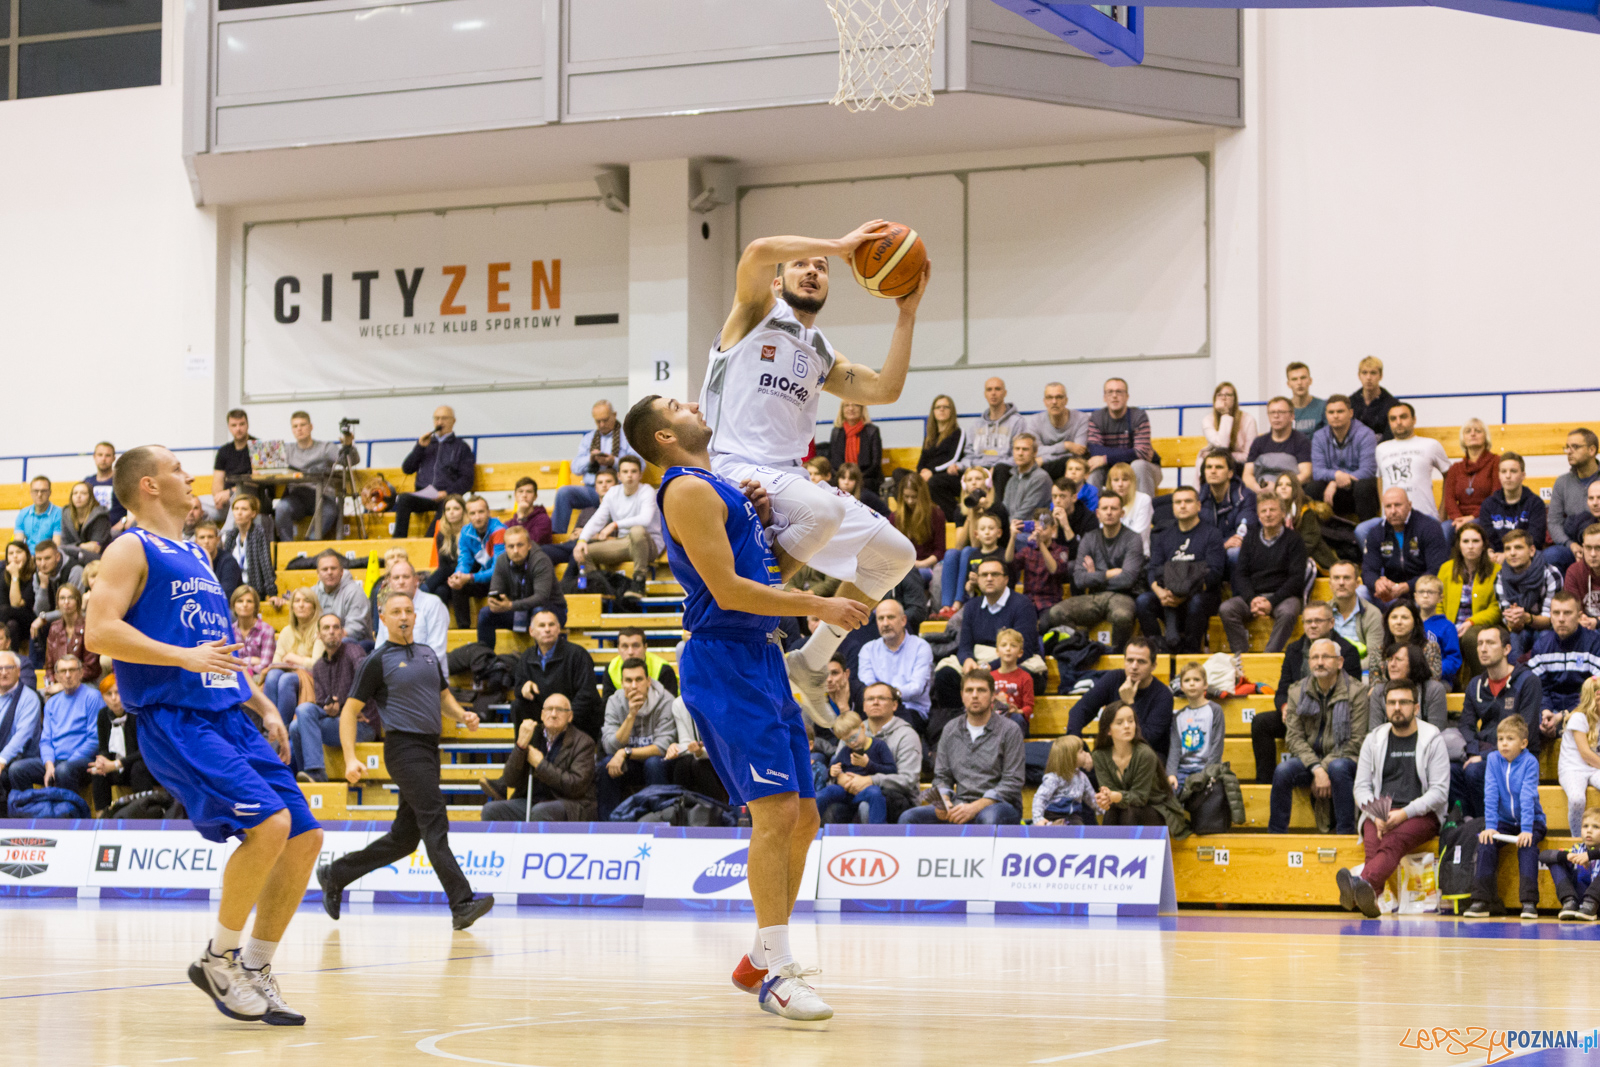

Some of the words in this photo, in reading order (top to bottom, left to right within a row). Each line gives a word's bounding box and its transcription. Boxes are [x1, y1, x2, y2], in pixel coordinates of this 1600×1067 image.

[274, 258, 562, 324] CITYZEN
[359, 323, 406, 339] WIĘCEJ
[443, 319, 478, 333] KLUB
[485, 314, 562, 331] SPORTOWY
[654, 360, 671, 381] B
[792, 349, 809, 379] 6
[1101, 632, 1107, 642] 2
[1244, 710, 1255, 720] 15
[370, 757, 376, 767] 9
[314, 796, 319, 806] 9
[4, 849, 46, 862] JOKER
[128, 848, 217, 871] NICKEL
[1216, 852, 1229, 862] 14
[1290, 854, 1302, 865] 13
[839, 857, 887, 878] KIA
[916, 858, 985, 878] DELIK
[1001, 852, 1148, 880] BIOFARM
[1011, 882, 1042, 890] POLSKI
[1046, 882, 1099, 891] PRODUCENT
[1103, 882, 1134, 891] LEKÓW
